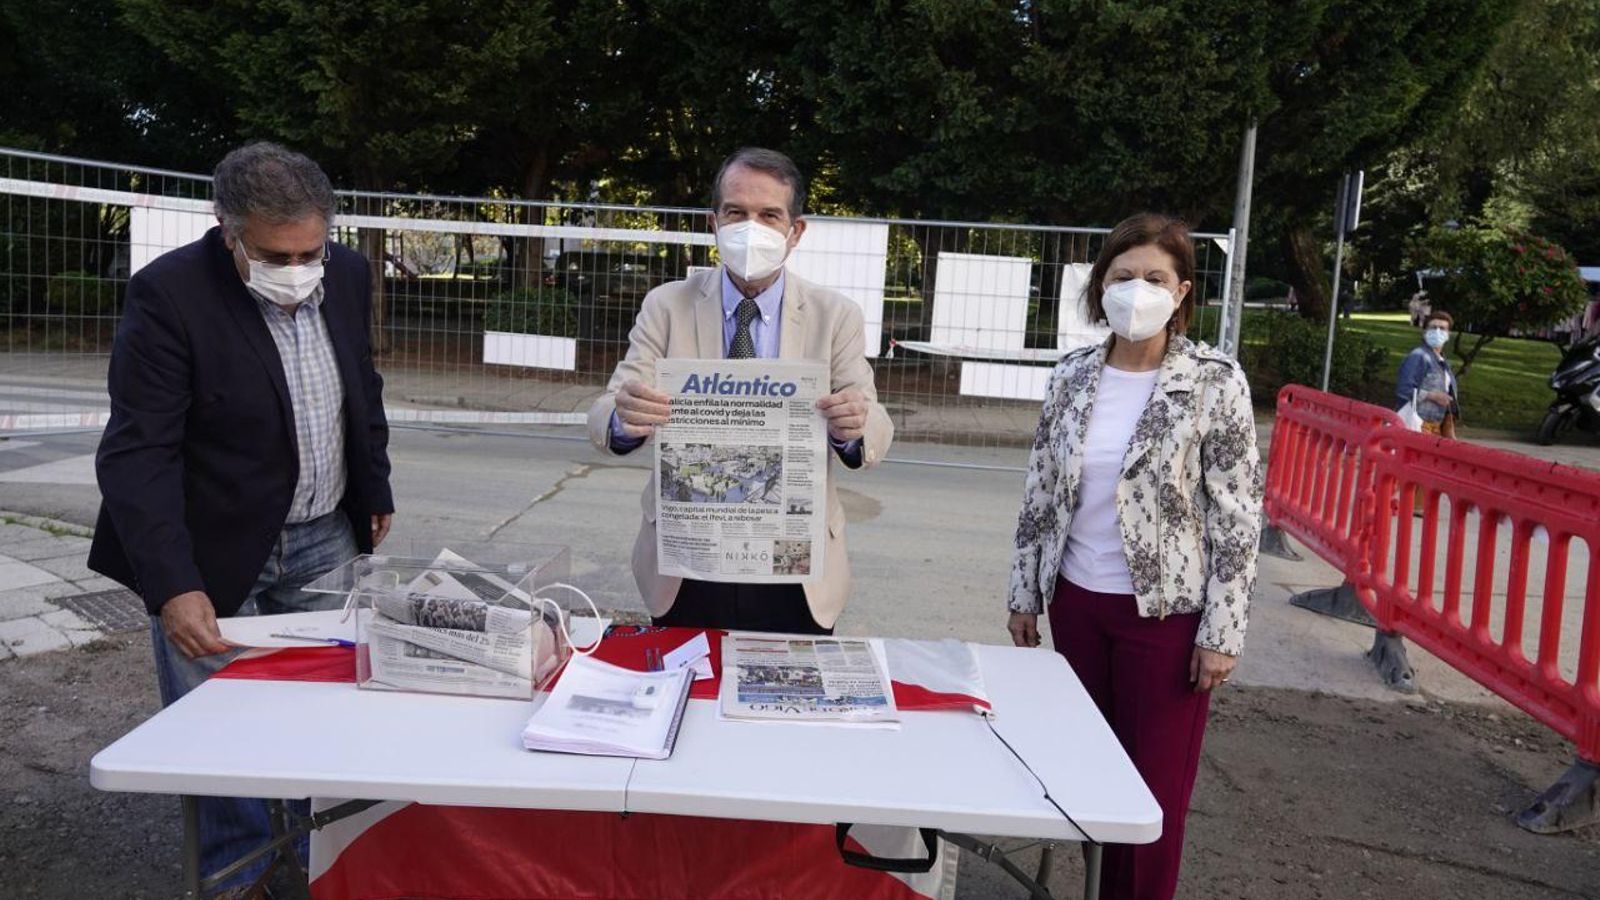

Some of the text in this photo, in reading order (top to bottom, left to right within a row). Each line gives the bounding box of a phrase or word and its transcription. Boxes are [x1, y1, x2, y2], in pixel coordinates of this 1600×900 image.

[681, 372, 797, 397] Atlántico
[721, 399, 729, 407] la
[731, 400, 783, 409] normalidad
[690, 407, 698, 416] al
[700, 408, 724, 417] covid
[725, 410, 731, 418] y
[731, 408, 750, 418] deja
[752, 409, 766, 417] las
[721, 417, 729, 425] al
[706, 506, 736, 514] mundial
[738, 506, 747, 514] de
